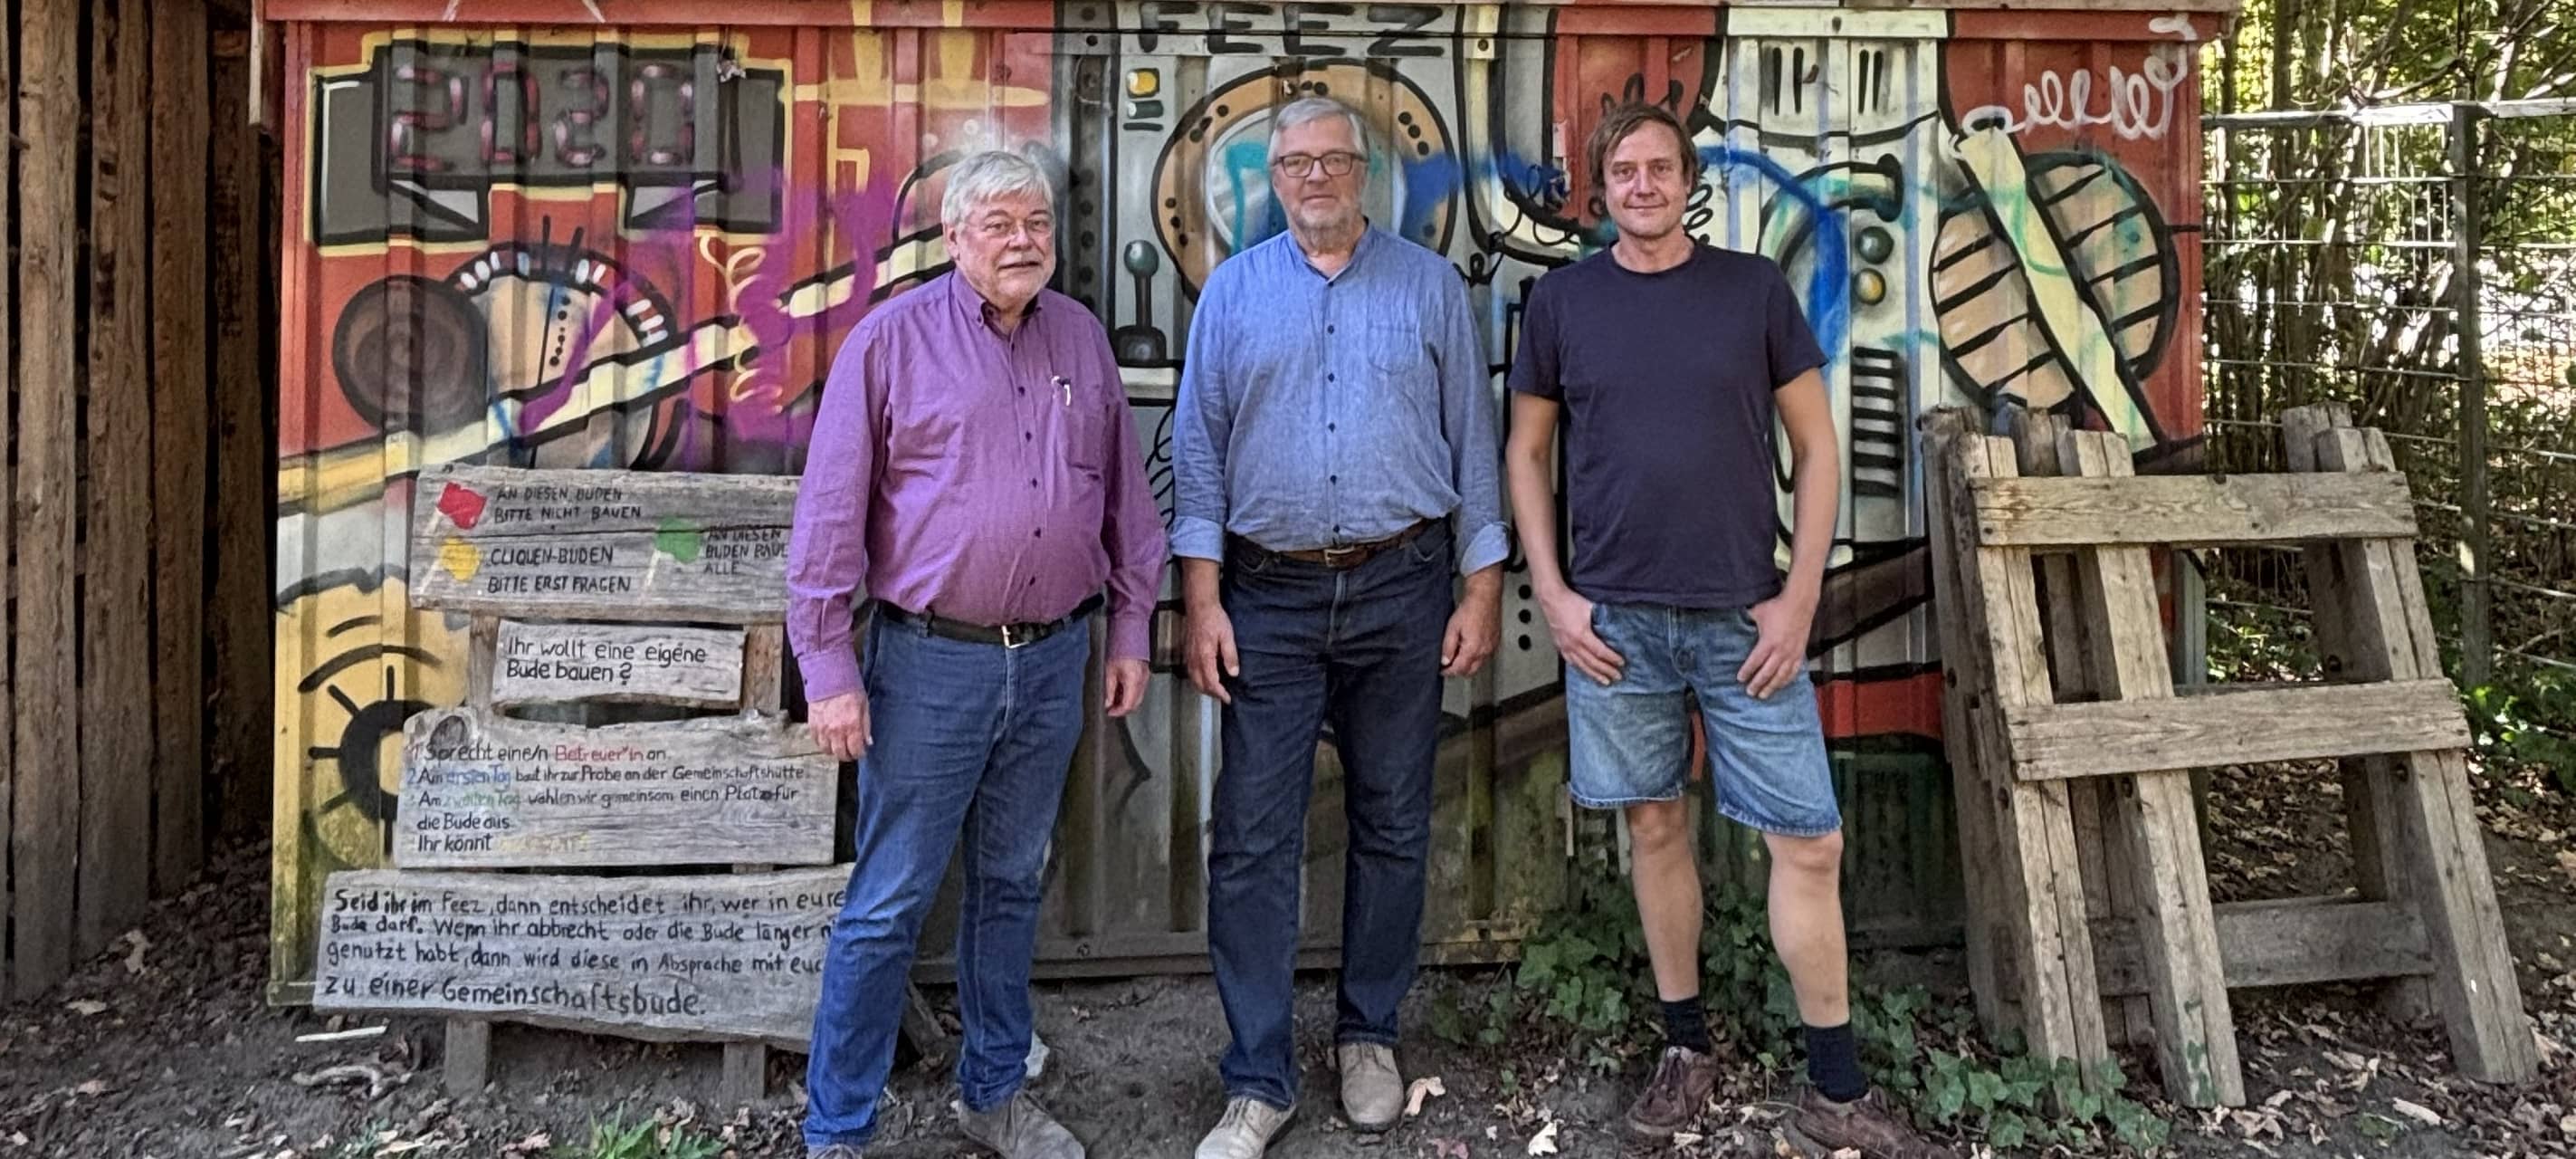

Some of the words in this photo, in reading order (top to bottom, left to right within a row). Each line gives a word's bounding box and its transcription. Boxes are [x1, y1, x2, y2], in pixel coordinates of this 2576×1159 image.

[1139, 2, 1445, 56] FEEZ
[389, 61, 694, 172] 2020
[497, 487, 518, 501] AN
[524, 486, 568, 501] DIESEN
[494, 507, 533, 523] BITTE
[541, 506, 580, 520] NICHT
[591, 506, 641, 521] BAUEN
[707, 524, 728, 541] AN
[732, 527, 782, 542] DIESEN
[491, 546, 614, 566] CLIQUEN-BUDEN
[705, 543, 749, 559] BUDEN
[704, 560, 740, 575] ALLE
[487, 575, 529, 593] BITTE
[535, 575, 568, 591] ERST
[573, 575, 632, 592] FRAGEN
[508, 637, 534, 656] Ihr
[540, 638, 586, 658] wollt
[595, 641, 634, 660] eine
[506, 658, 550, 679] Bude
[556, 660, 614, 682] bauen
[425, 742, 493, 769] Sprecht
[416, 767, 444, 785] Am
[581, 764, 622, 782] Probe
[625, 771, 640, 781] an
[643, 767, 667, 781] der
[418, 790, 442, 808] Am
[680, 786, 720, 802] einen
[416, 814, 441, 830] die
[444, 811, 481, 830] Bude
[418, 834, 442, 852] Ihr
[444, 832, 493, 852] könnt
[334, 888, 379, 913] Seid
[384, 891, 406, 915] ihr
[411, 891, 433, 914] im
[549, 894, 665, 915] entscheidet
[721, 896, 759, 914] wer
[769, 891, 788, 910] in
[330, 914, 367, 934] Bude
[375, 915, 424, 934] darf.
[434, 918, 486, 940] Wenn
[493, 916, 520, 936] ihr
[527, 918, 610, 939] abbrecht
[623, 922, 659, 941] oder
[667, 919, 694, 941] die
[701, 922, 745, 942] Bude
[327, 941, 406, 966] genutzt
[523, 948, 559, 969] wird
[570, 948, 620, 970] diese
[631, 951, 649, 972] in
[658, 952, 743, 982] Absprache
[752, 953, 786, 972] mit
[789, 955, 823, 974] euc
[324, 975, 356, 996] zu
[369, 972, 436, 1000] einer
[443, 976, 707, 1016] Gemeinschaftsbude.
